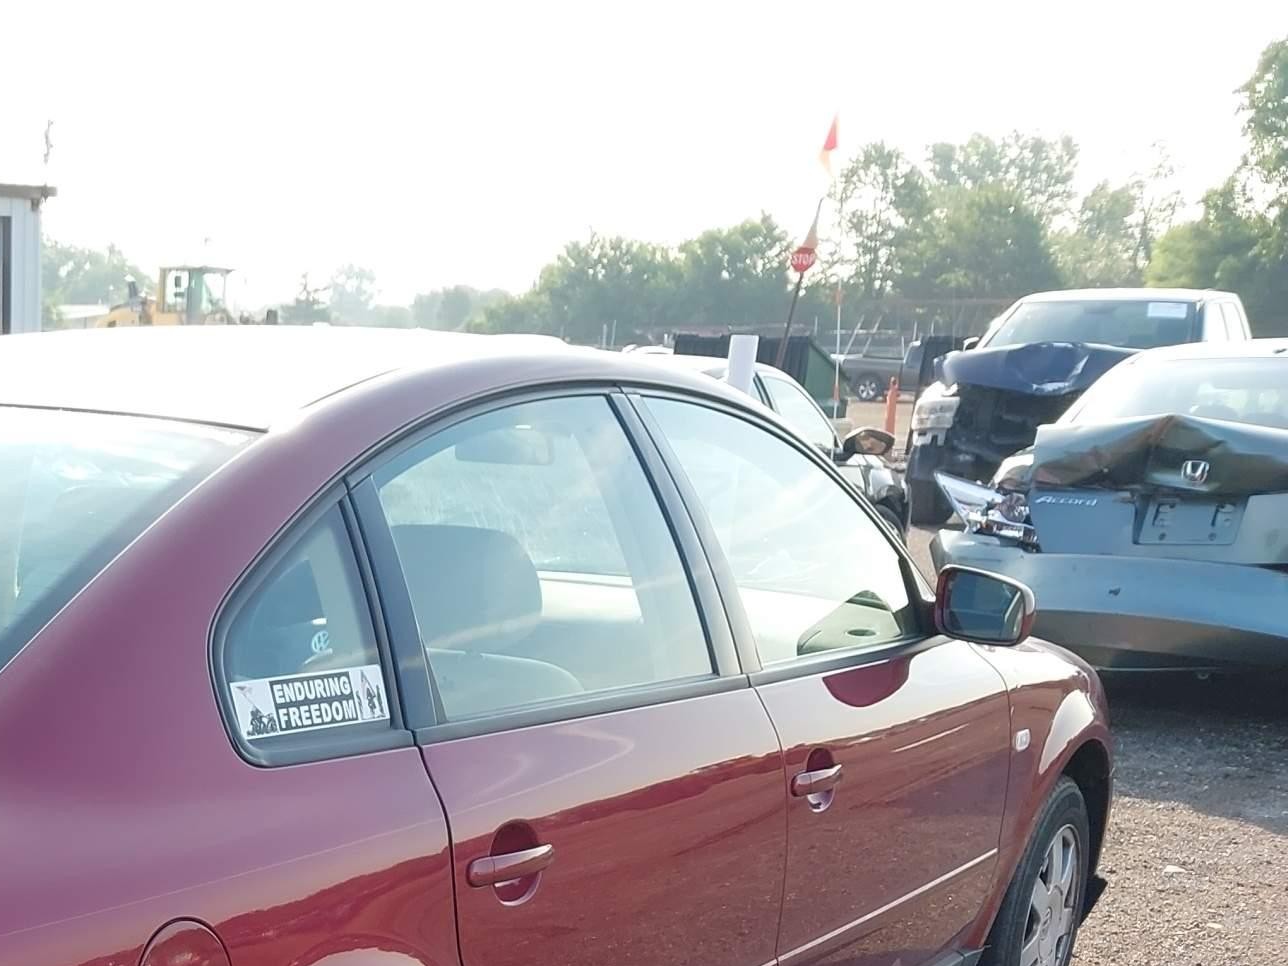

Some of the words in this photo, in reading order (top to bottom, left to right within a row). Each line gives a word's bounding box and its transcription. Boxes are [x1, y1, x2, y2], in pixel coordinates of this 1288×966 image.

[791, 252, 816, 266] STOP
[1034, 494, 1098, 507] Accord
[272, 675, 351, 705] ENDURING
[278, 700, 357, 729] FREEDOM
